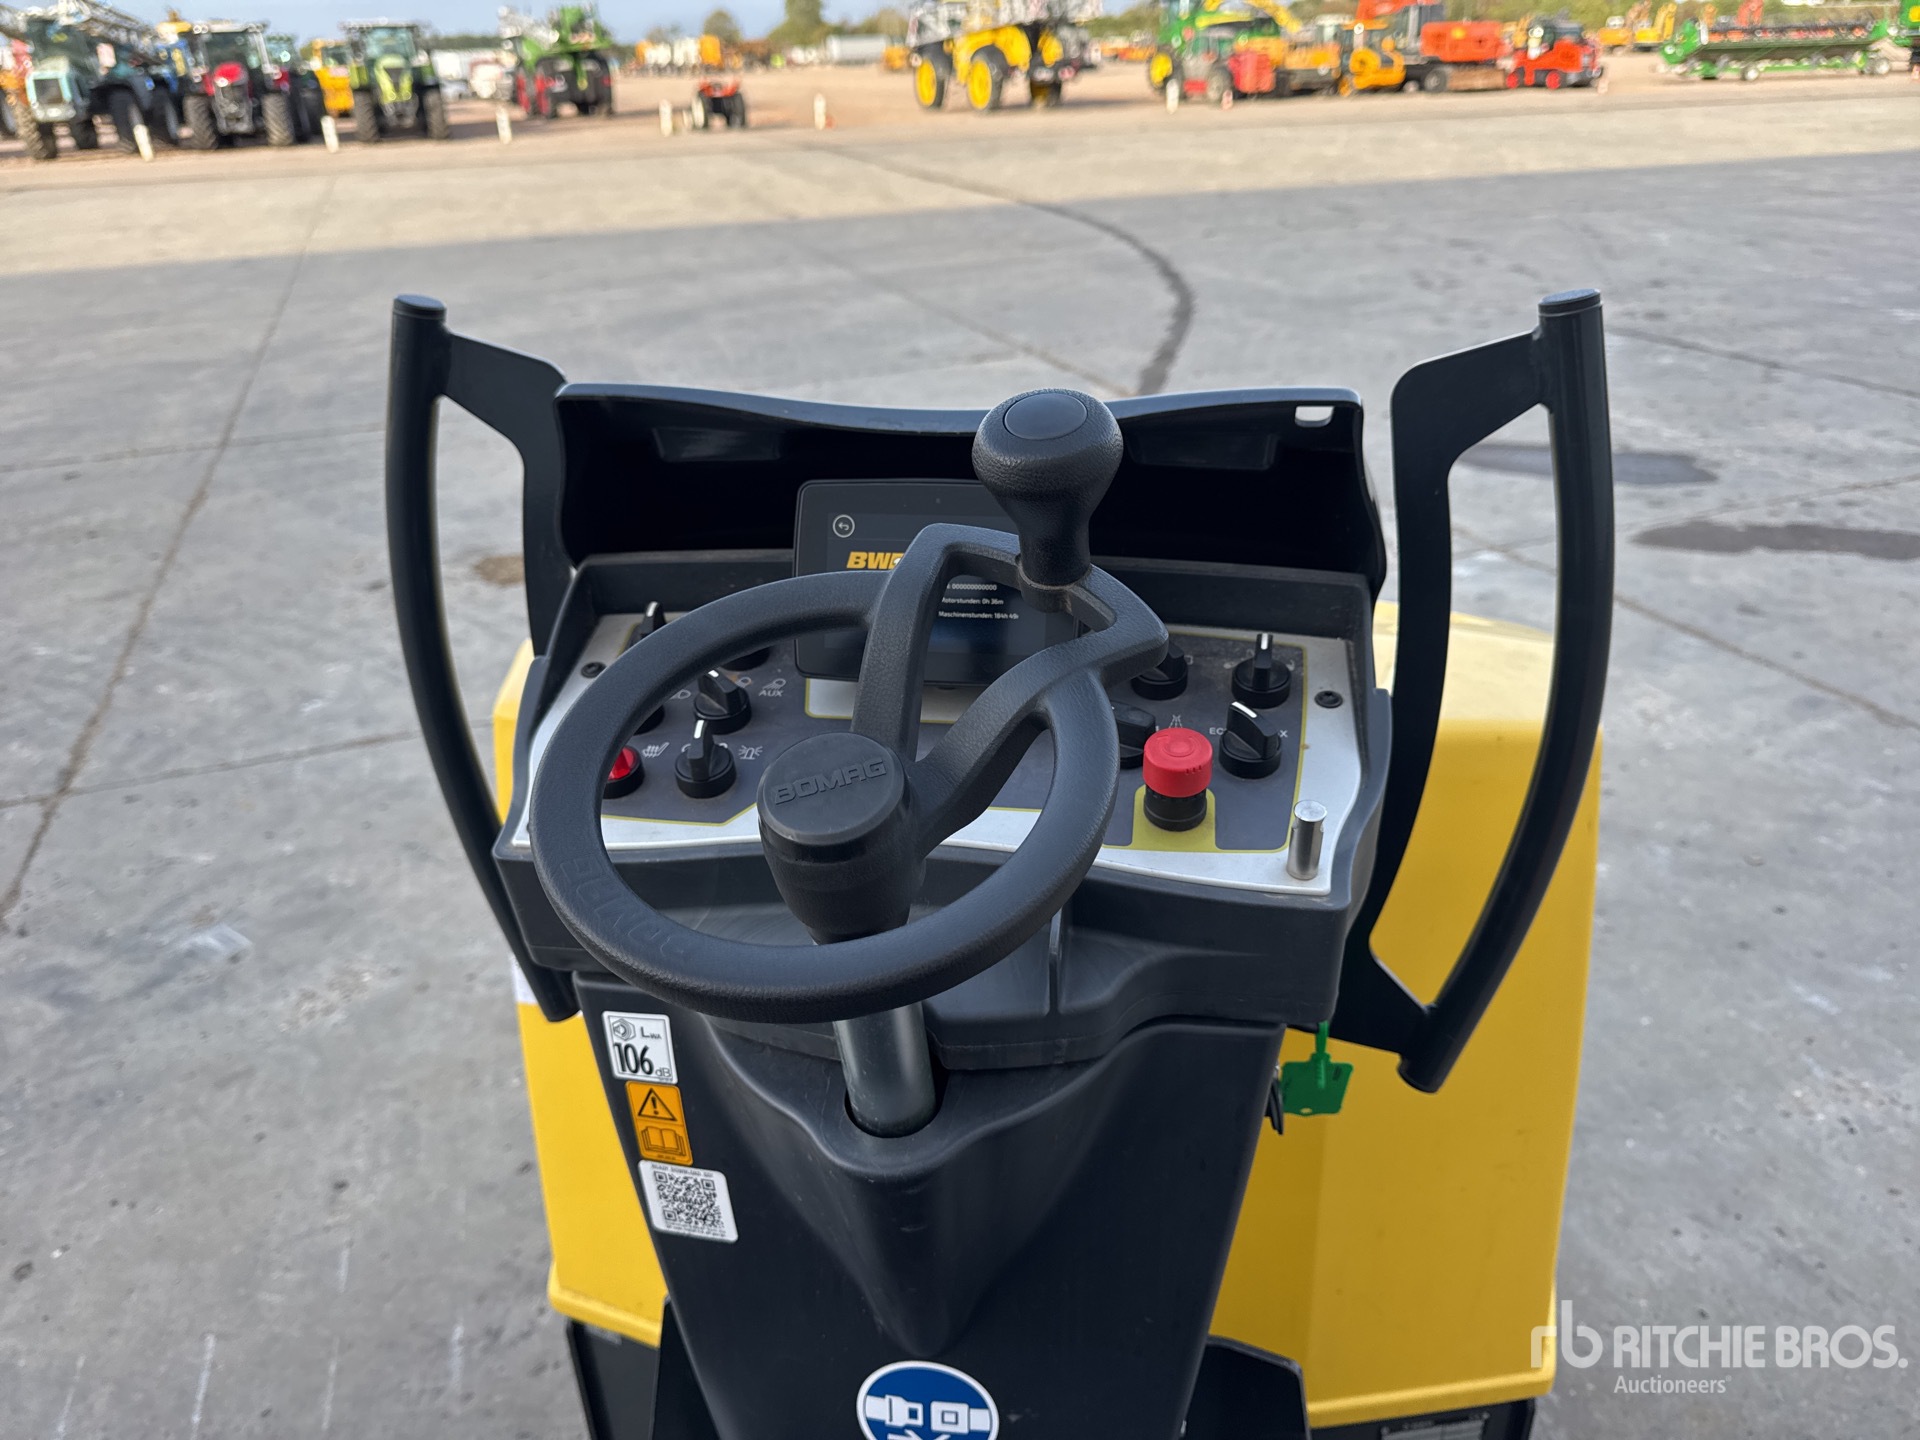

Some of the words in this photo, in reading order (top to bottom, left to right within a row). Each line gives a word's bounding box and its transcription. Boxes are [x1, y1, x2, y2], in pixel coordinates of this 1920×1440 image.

[1209, 727, 1226, 735] EC
[774, 757, 888, 805] BOMAG
[613, 1043, 654, 1075] 106
[655, 1067, 672, 1077] dB
